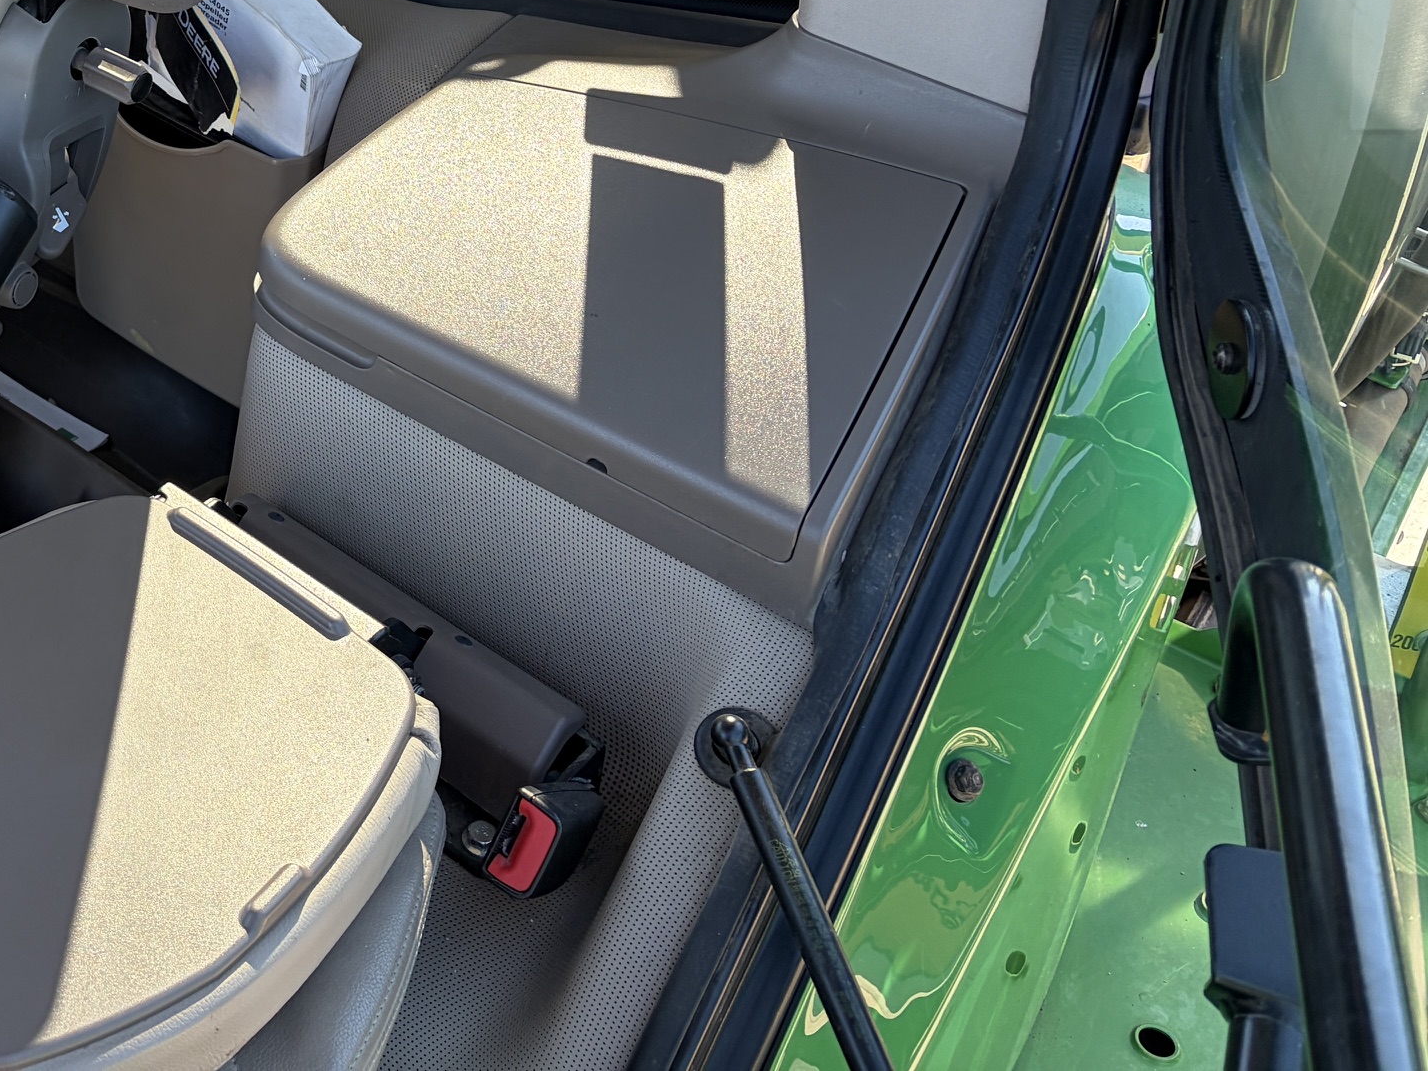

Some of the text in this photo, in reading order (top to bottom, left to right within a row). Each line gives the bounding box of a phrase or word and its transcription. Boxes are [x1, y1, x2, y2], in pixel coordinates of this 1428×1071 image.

[200, 1, 228, 24] opelled
[200, 9, 228, 31] reader
[178, 9, 220, 79] DEERE
